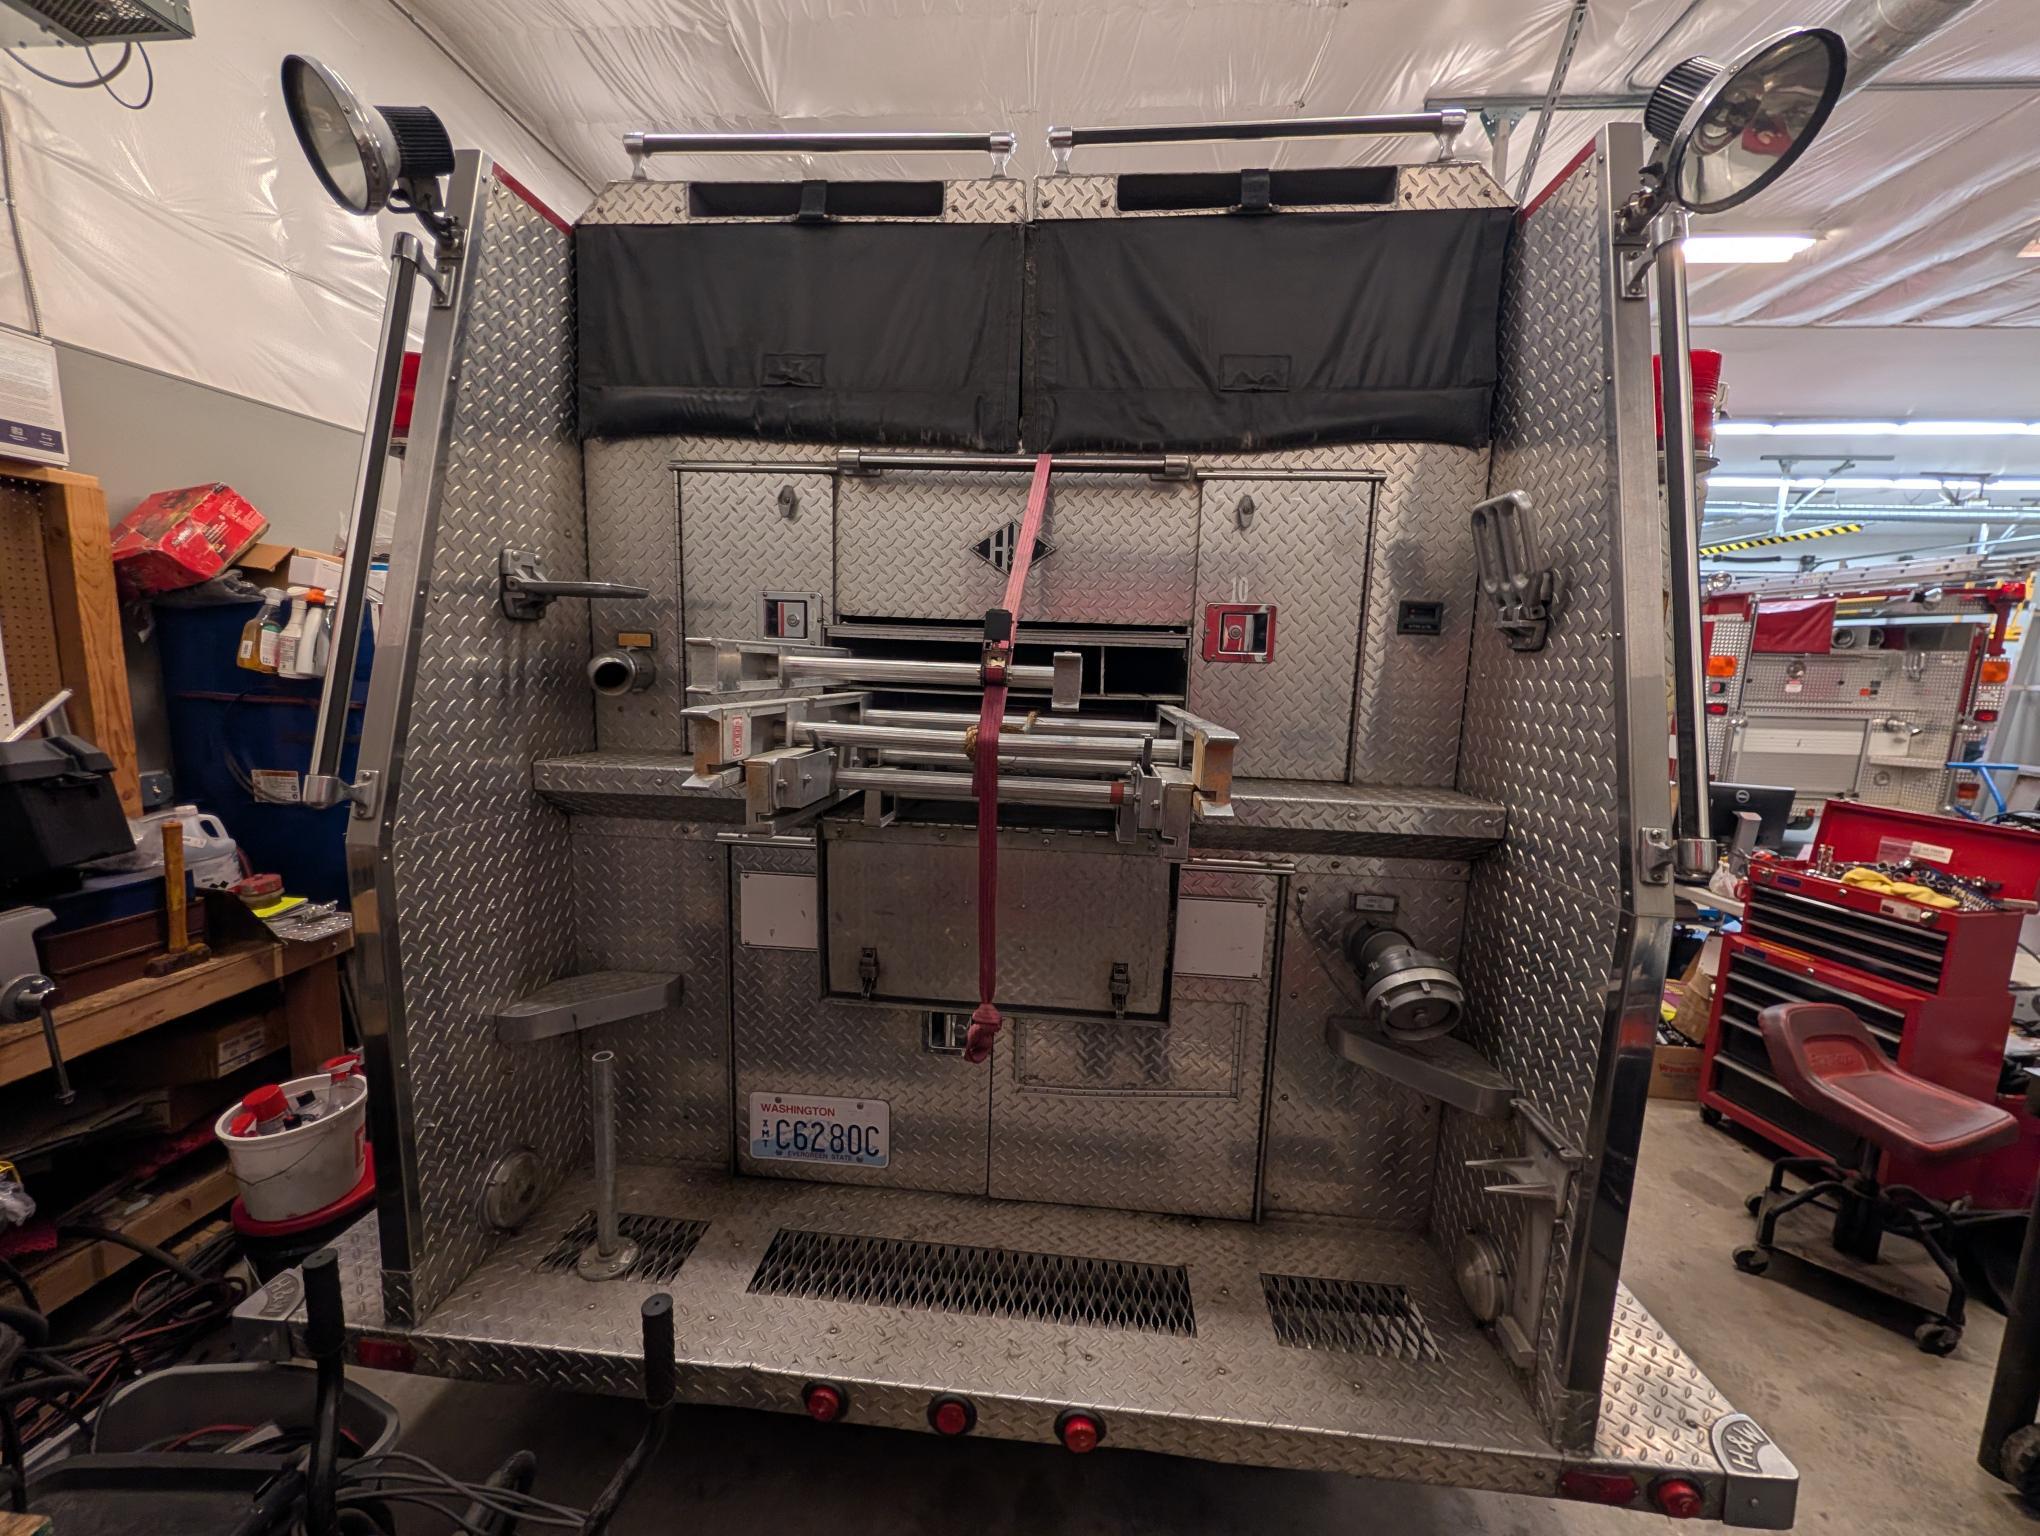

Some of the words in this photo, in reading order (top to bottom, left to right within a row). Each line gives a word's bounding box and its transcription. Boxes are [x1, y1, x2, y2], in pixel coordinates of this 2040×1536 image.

[1230, 576, 1249, 603] 10
[760, 1103, 836, 1117] WASHINGTON
[776, 1119, 880, 1157] C6280C
[787, 1151, 828, 1160] EVERGREEN
[1726, 1422, 1766, 1470] H&W
